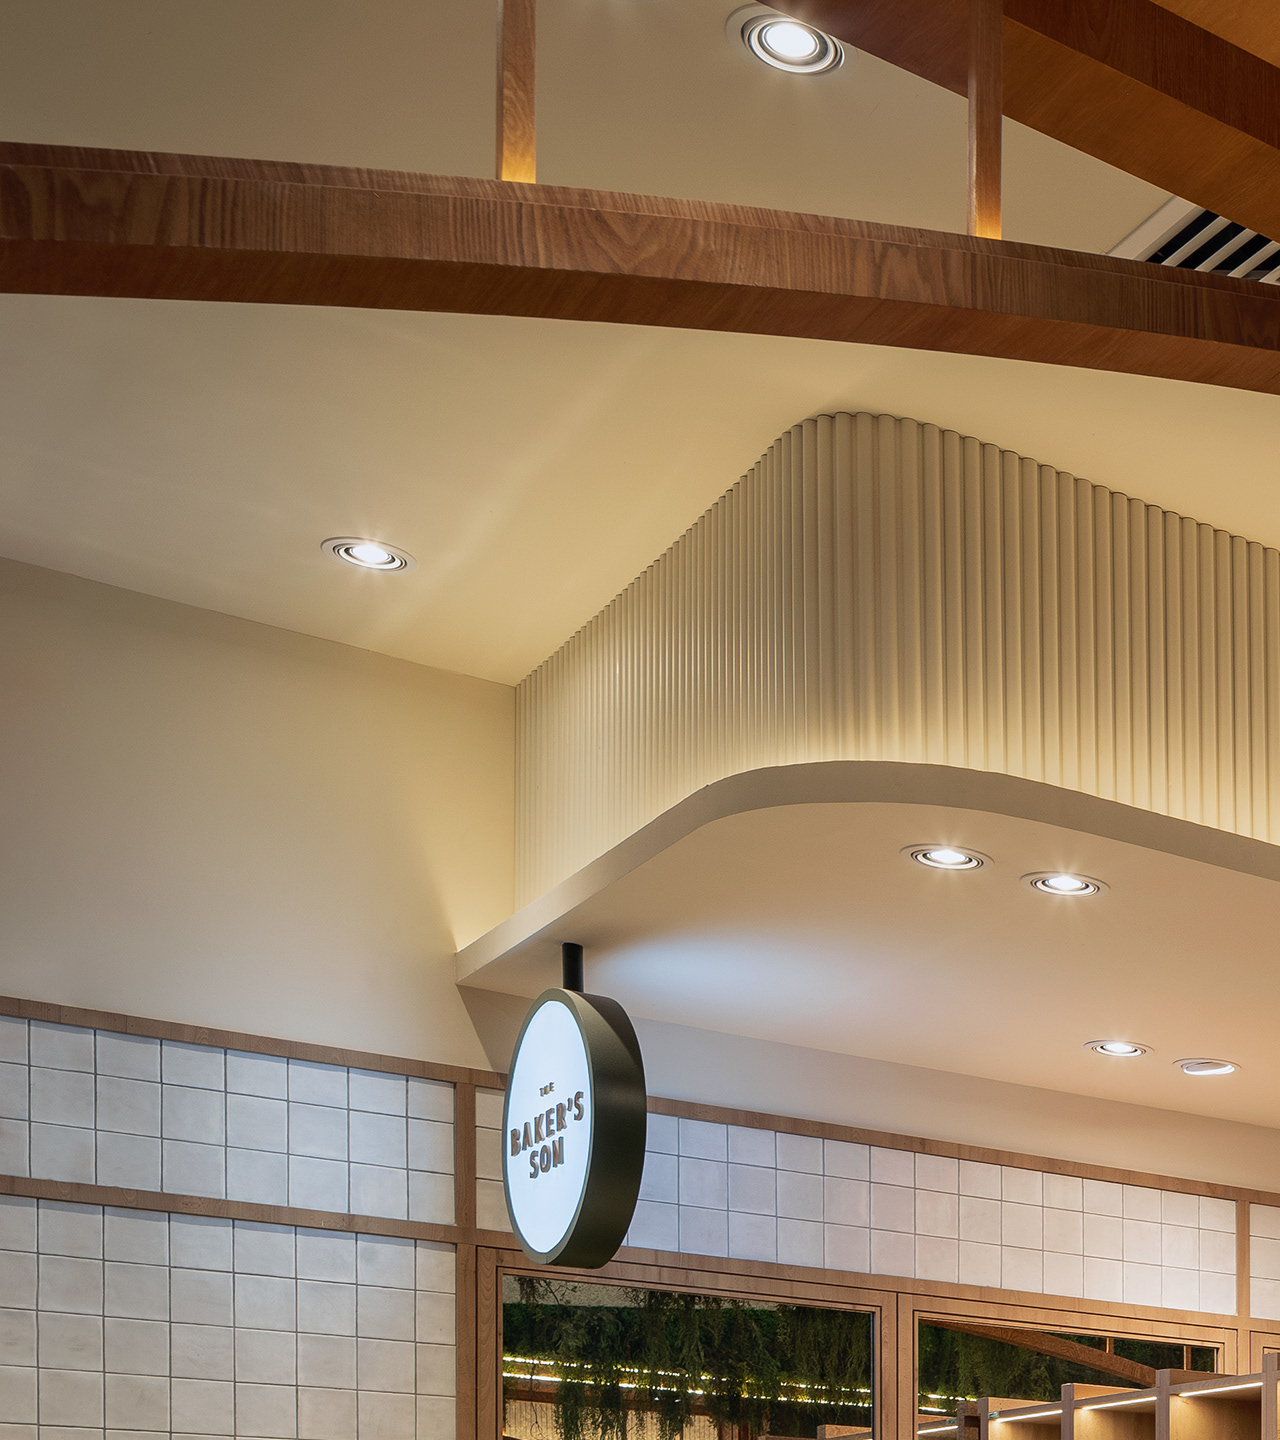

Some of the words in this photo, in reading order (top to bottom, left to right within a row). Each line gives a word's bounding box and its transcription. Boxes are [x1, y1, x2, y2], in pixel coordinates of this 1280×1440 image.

[539, 1081, 555, 1098] THE
[510, 1091, 584, 1157] BAKER'S
[529, 1136, 565, 1179] SON
